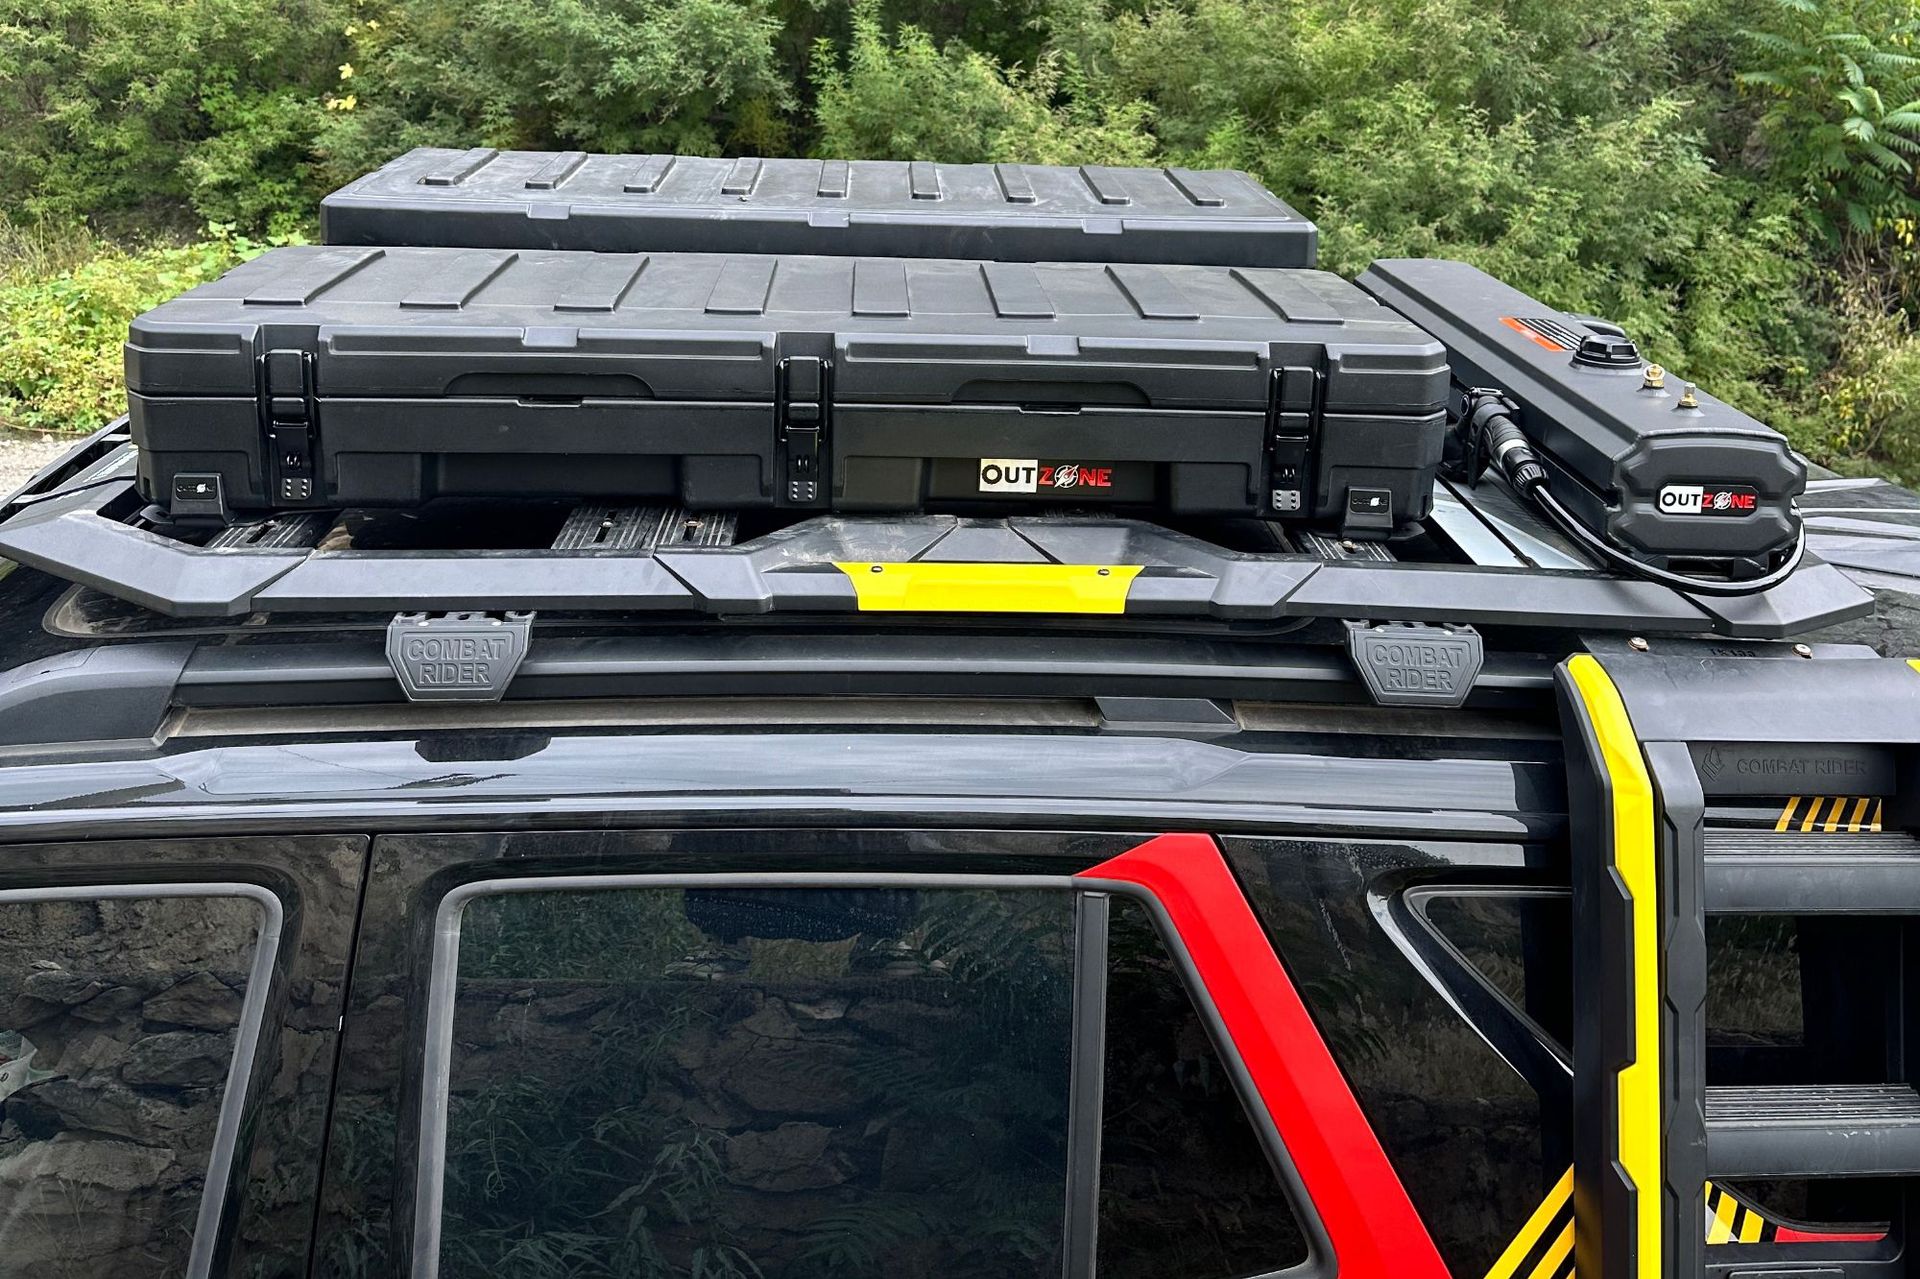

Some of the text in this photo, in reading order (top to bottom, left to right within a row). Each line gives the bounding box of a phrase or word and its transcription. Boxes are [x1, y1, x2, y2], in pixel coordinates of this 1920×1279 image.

[407, 638, 506, 661] COMBAT
[1372, 644, 1463, 669] COMBAT
[419, 662, 490, 684] RIDER
[1385, 668, 1453, 690] RIDER
[1736, 758, 1867, 775] COMBAT RIDER
